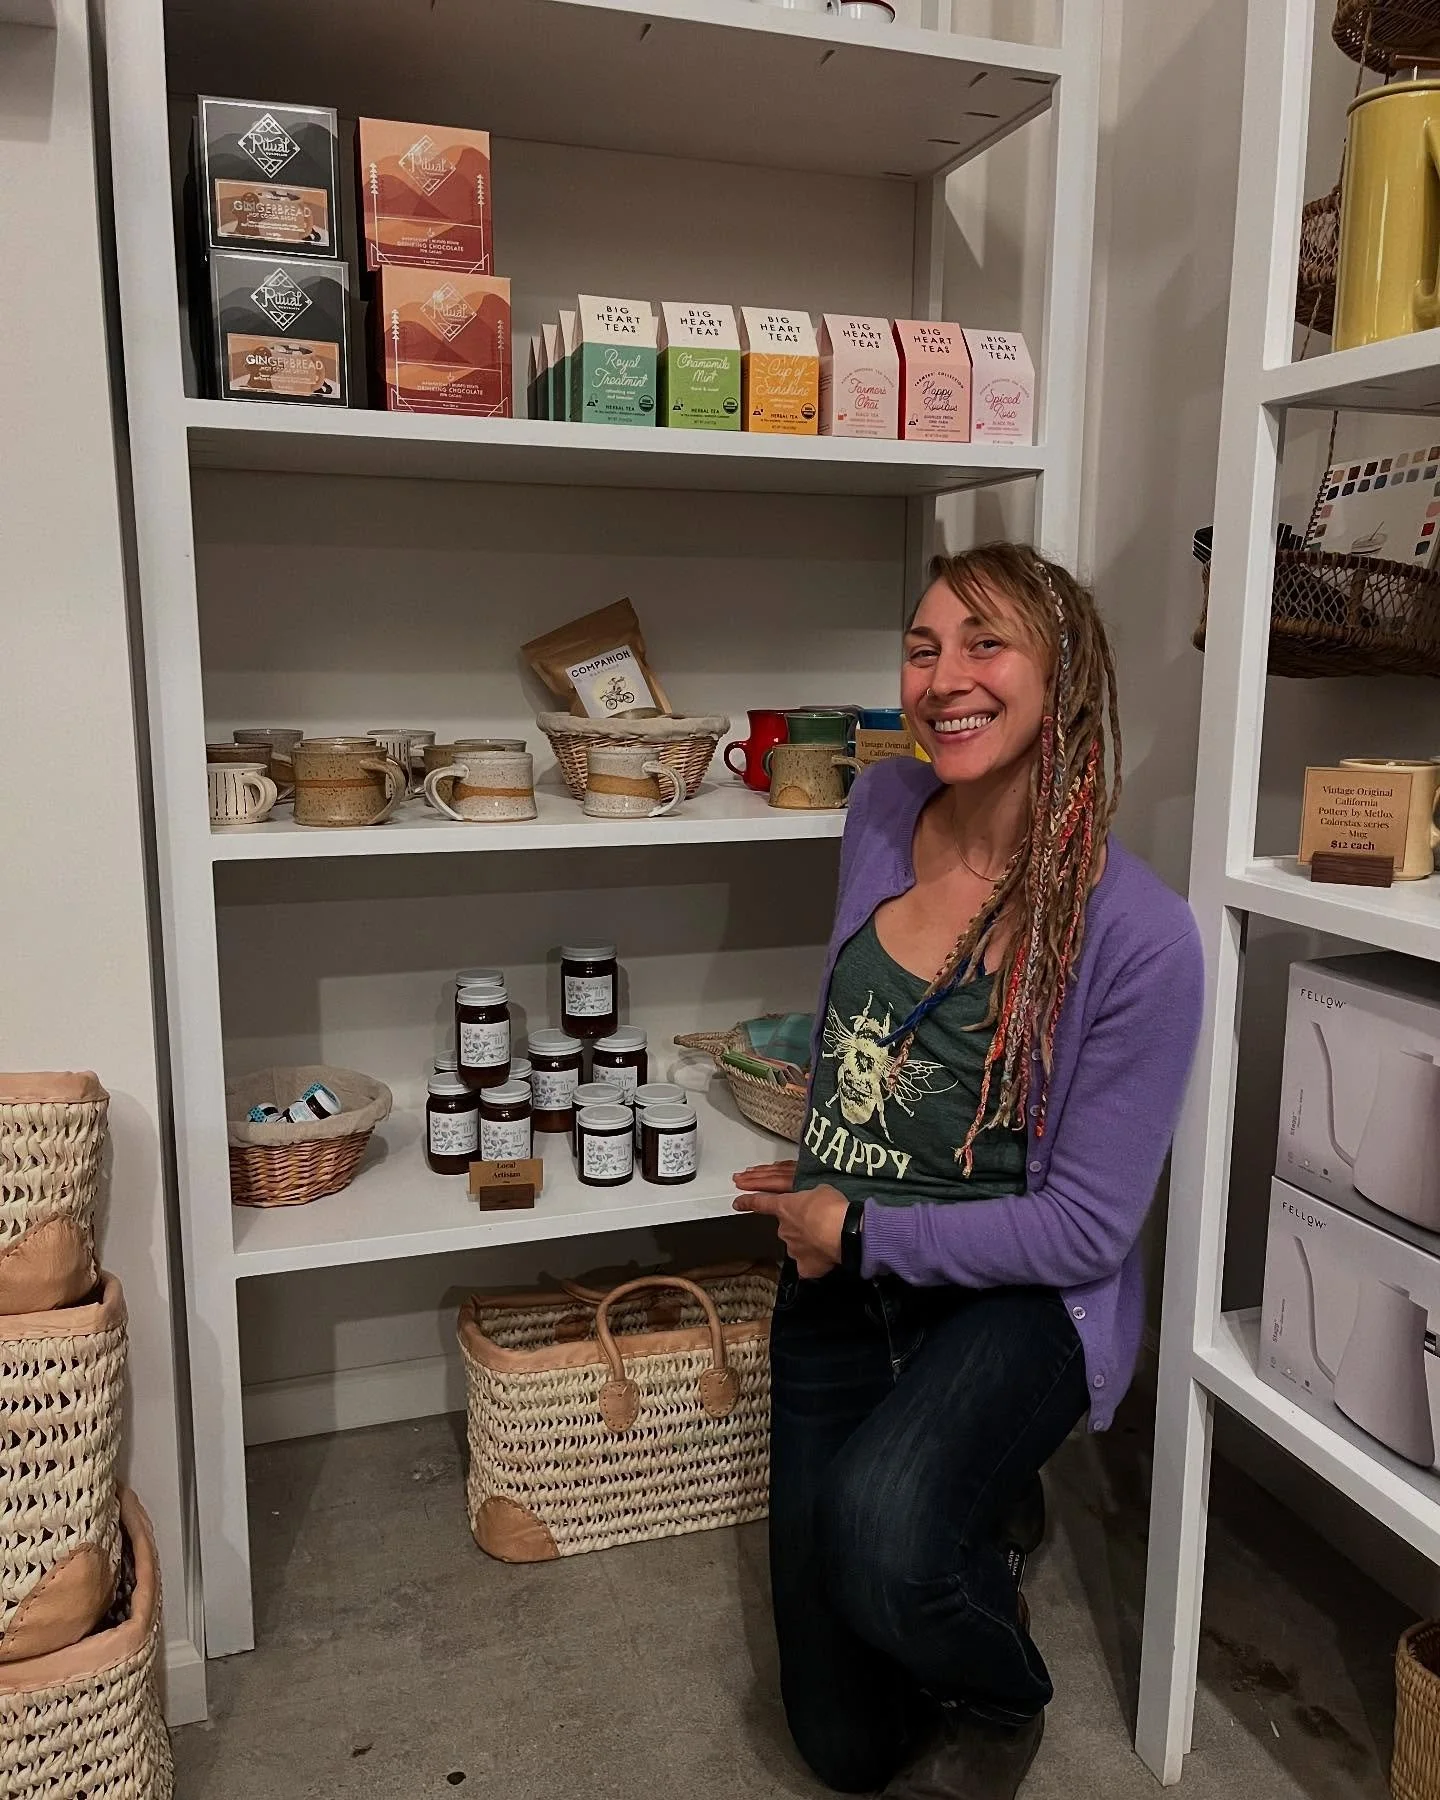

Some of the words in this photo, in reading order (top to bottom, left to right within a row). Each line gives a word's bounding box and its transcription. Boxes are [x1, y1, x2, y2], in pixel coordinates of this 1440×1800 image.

[233, 200, 312, 218] GINGERBREAD
[429, 244, 464, 252] CHOCOLATE
[607, 306, 629, 314] BIG
[597, 314, 640, 324] HEART
[680, 318, 722, 327] HEART
[767, 316, 790, 324] BIG
[605, 324, 636, 333] TEAS
[760, 324, 801, 333] HEART
[849, 322, 871, 330] BIG
[688, 327, 719, 336] TEAS
[842, 330, 882, 340] HEART
[920, 328, 941, 336] BIG
[768, 333, 798, 342] TEAS
[914, 336, 952, 345] HEART
[986, 335, 1006, 343] BIG
[851, 339, 880, 349] TEAS
[921, 344, 950, 354] TEAS
[980, 343, 1017, 353] HEART
[988, 351, 1016, 361] TEAS
[246, 354, 324, 370] GINGERBREAD
[604, 348, 641, 375] Royal
[768, 358, 792, 382] Cup
[448, 387, 483, 396] CHOCOLATE
[922, 380, 953, 401] Happy
[855, 393, 879, 410] Chai
[984, 388, 1021, 410] Spiced
[571, 650, 630, 677] COMPANION
[884, 741, 911, 750] Original
[1322, 785, 1355, 796] Vintage
[1357, 788, 1393, 798] Original
[1335, 798, 1378, 807] California
[1318, 807, 1348, 818] Pottery
[1351, 808, 1361, 818] by
[1364, 809, 1394, 819] Metlox
[1320, 818, 1361, 828] Colorstax
[1363, 821, 1390, 829] series
[1349, 830, 1368, 839] Mug
[1330, 840, 1348, 849] $12
[1350, 841, 1375, 851] each
[1301, 988, 1344, 1009] FELLOW
[804, 1107, 913, 1180] HAPPY
[497, 1161, 516, 1169] Local
[1282, 1201, 1324, 1229] FELLOW
